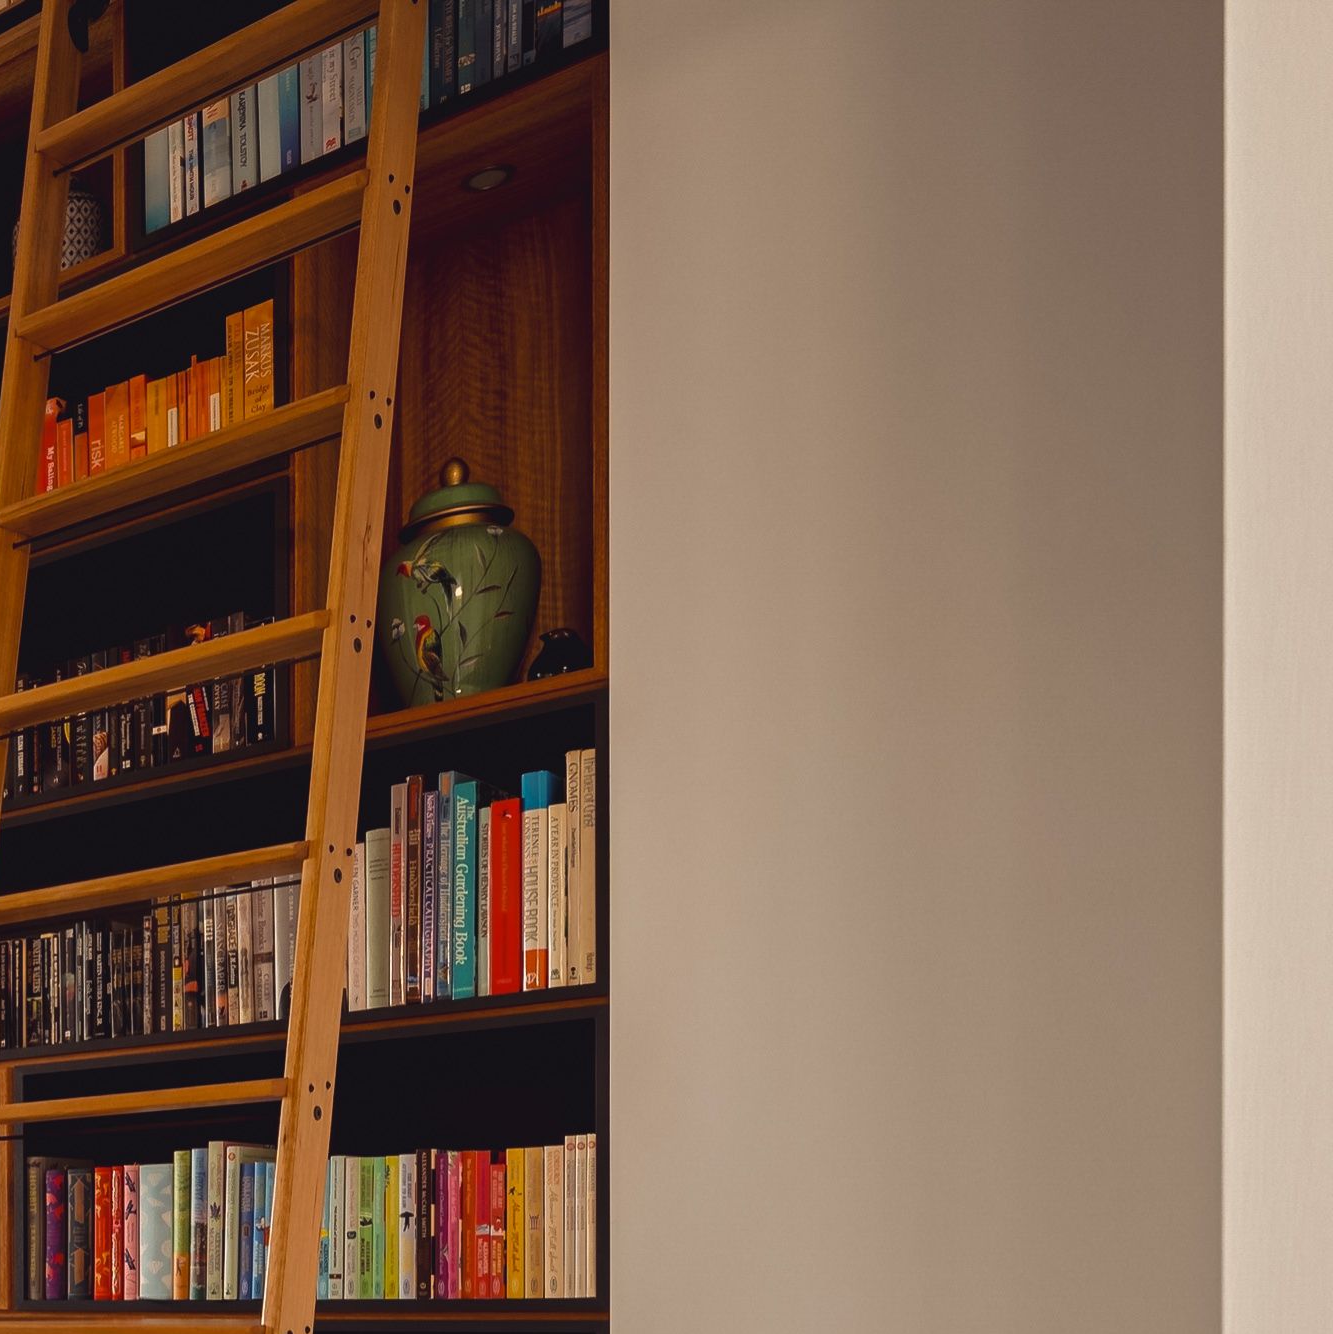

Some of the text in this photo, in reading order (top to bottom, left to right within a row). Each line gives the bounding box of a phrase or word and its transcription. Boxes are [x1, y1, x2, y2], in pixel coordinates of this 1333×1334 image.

[329, 74, 337, 102] Street
[239, 133, 248, 168] TOLSTOY
[245, 327, 259, 384] ZUSAK
[260, 322, 271, 378] MARKUS
[45, 446, 55, 492] My Saling
[90, 439, 104, 470] risk
[254, 672, 266, 696] ROOM
[582, 756, 594, 774] The
[568, 762, 579, 813] GNOMES
[440, 820, 450, 836] The
[466, 805, 475, 821] The
[550, 823, 559, 849] YEAR
[551, 849, 559, 860] IN
[352, 852, 360, 879] HELEN
[439, 839, 450, 876] Heritage
[392, 843, 402, 919] HUDDERSFIELD
[408, 860, 418, 927] Huddersfield
[453, 795, 471, 966] Australian Gardening Book
[480, 823, 489, 939] STORIES OF HENRY LAWSON
[525, 815, 540, 942] TERENCE HOUSE BOOK
[551, 861, 560, 908] PROVENCE
[423, 842, 434, 973] PRACTICAL CALLIGRAPHY
[439, 888, 450, 941] Huddersfield
[258, 920, 267, 951] Brooks
